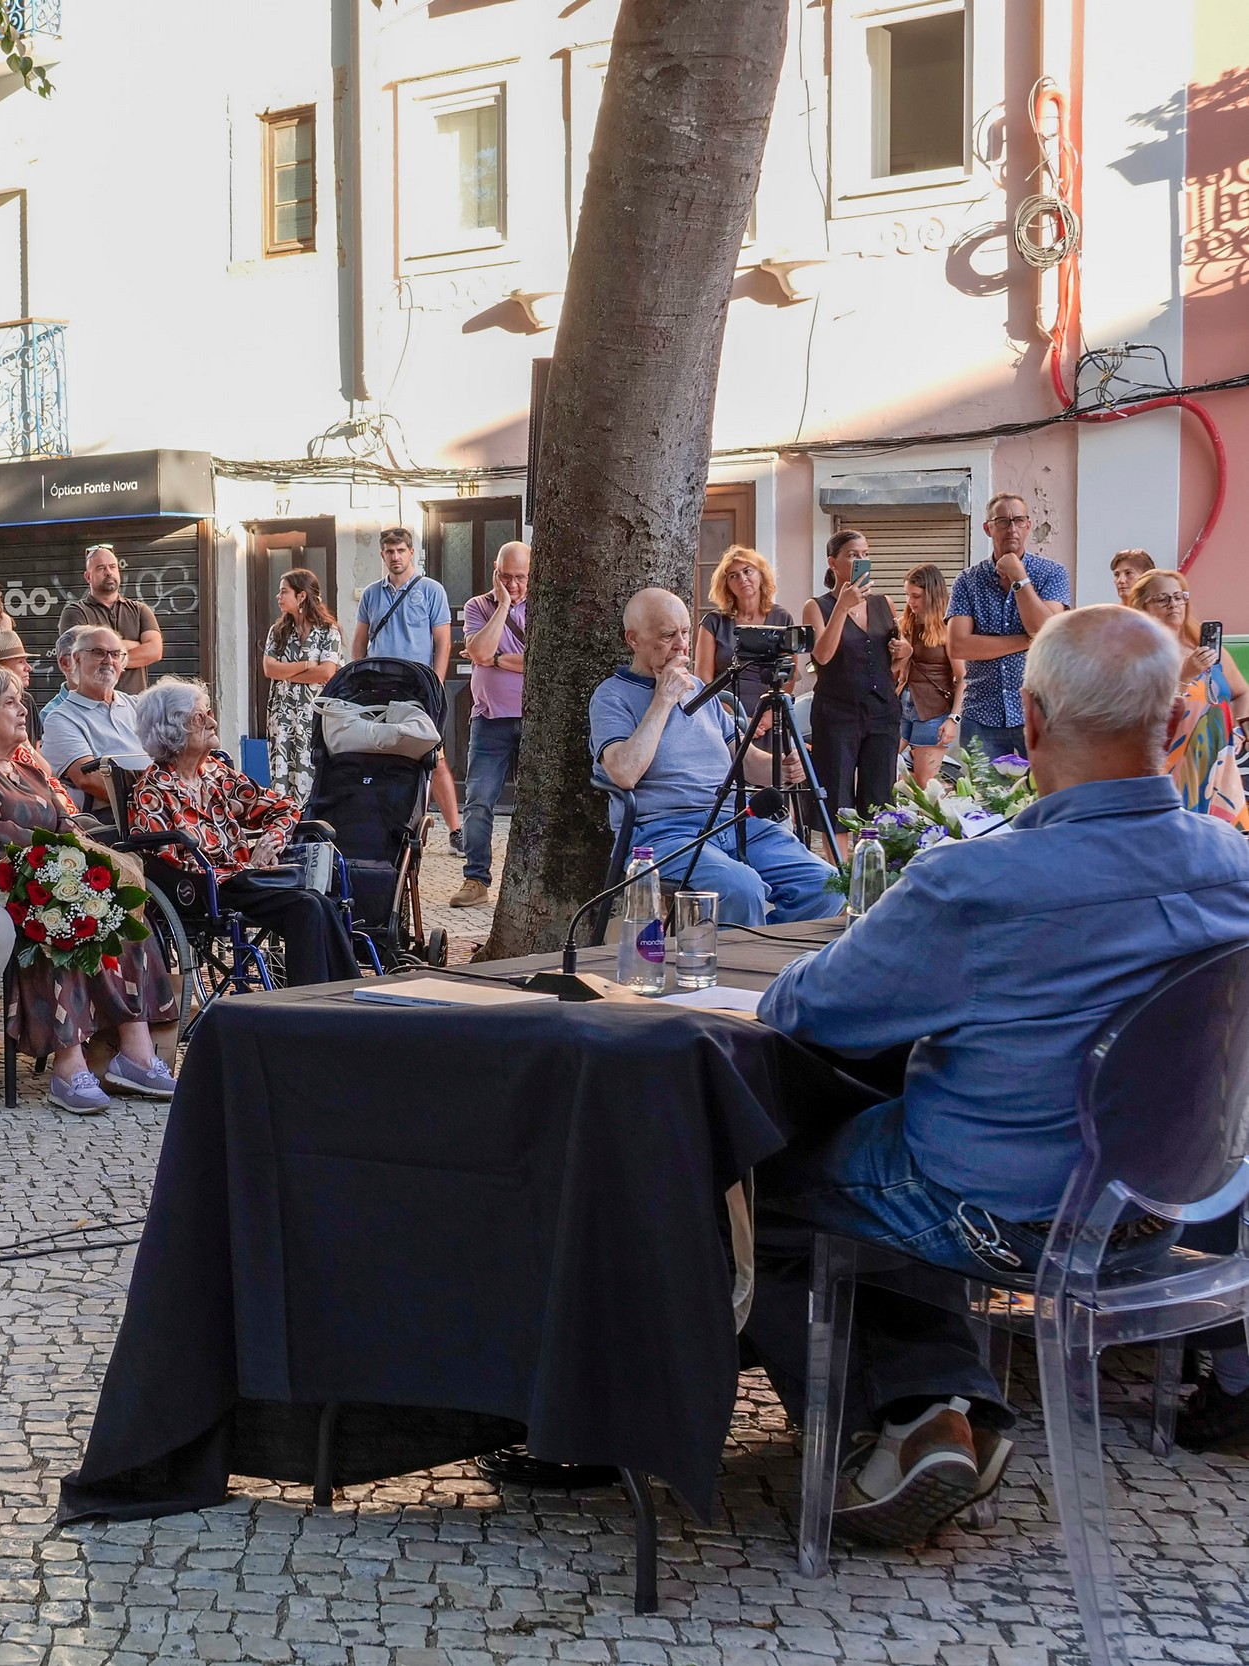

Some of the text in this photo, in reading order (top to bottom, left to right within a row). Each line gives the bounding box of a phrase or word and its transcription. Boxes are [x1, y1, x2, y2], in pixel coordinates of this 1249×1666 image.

[50, 480, 138, 500] Óptica Fonte Nova
[276, 499, 291, 516] 57
